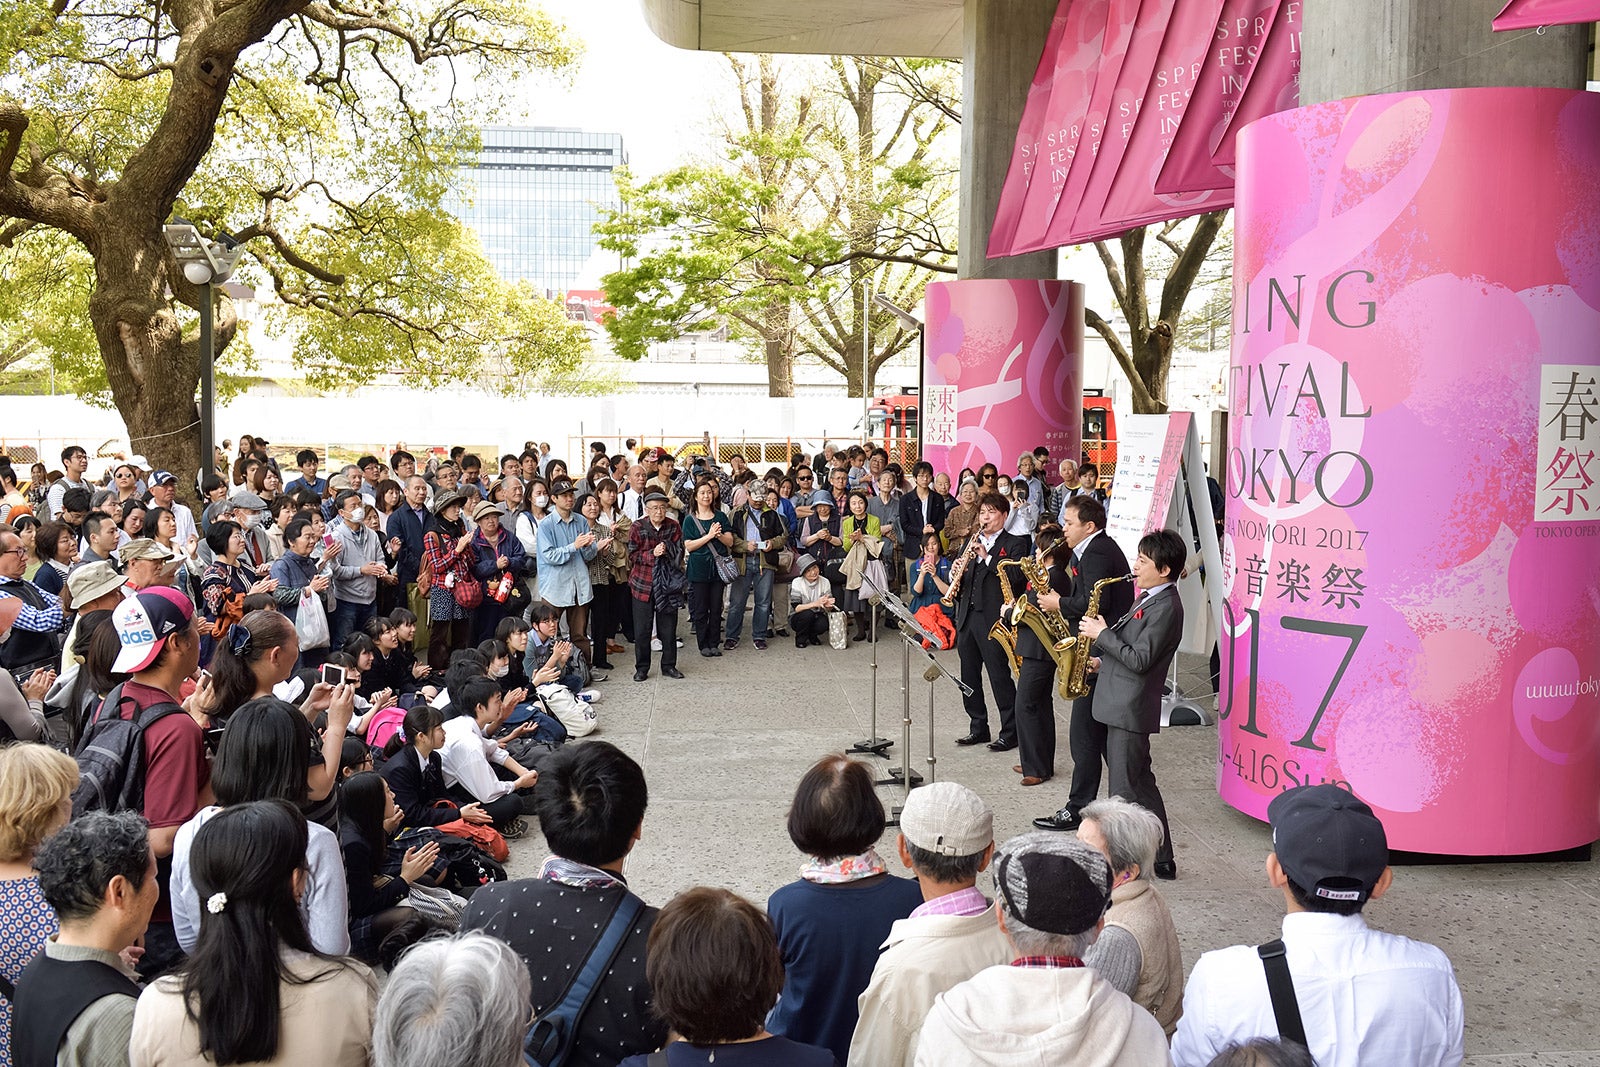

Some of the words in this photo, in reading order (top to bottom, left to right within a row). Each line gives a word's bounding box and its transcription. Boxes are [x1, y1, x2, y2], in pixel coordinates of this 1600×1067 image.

[937, 387, 955, 443] 東京
[1237, 519, 1307, 547] NOMORI
[1316, 527, 1370, 551] 2017
[1534, 526, 1573, 538] TOKYO
